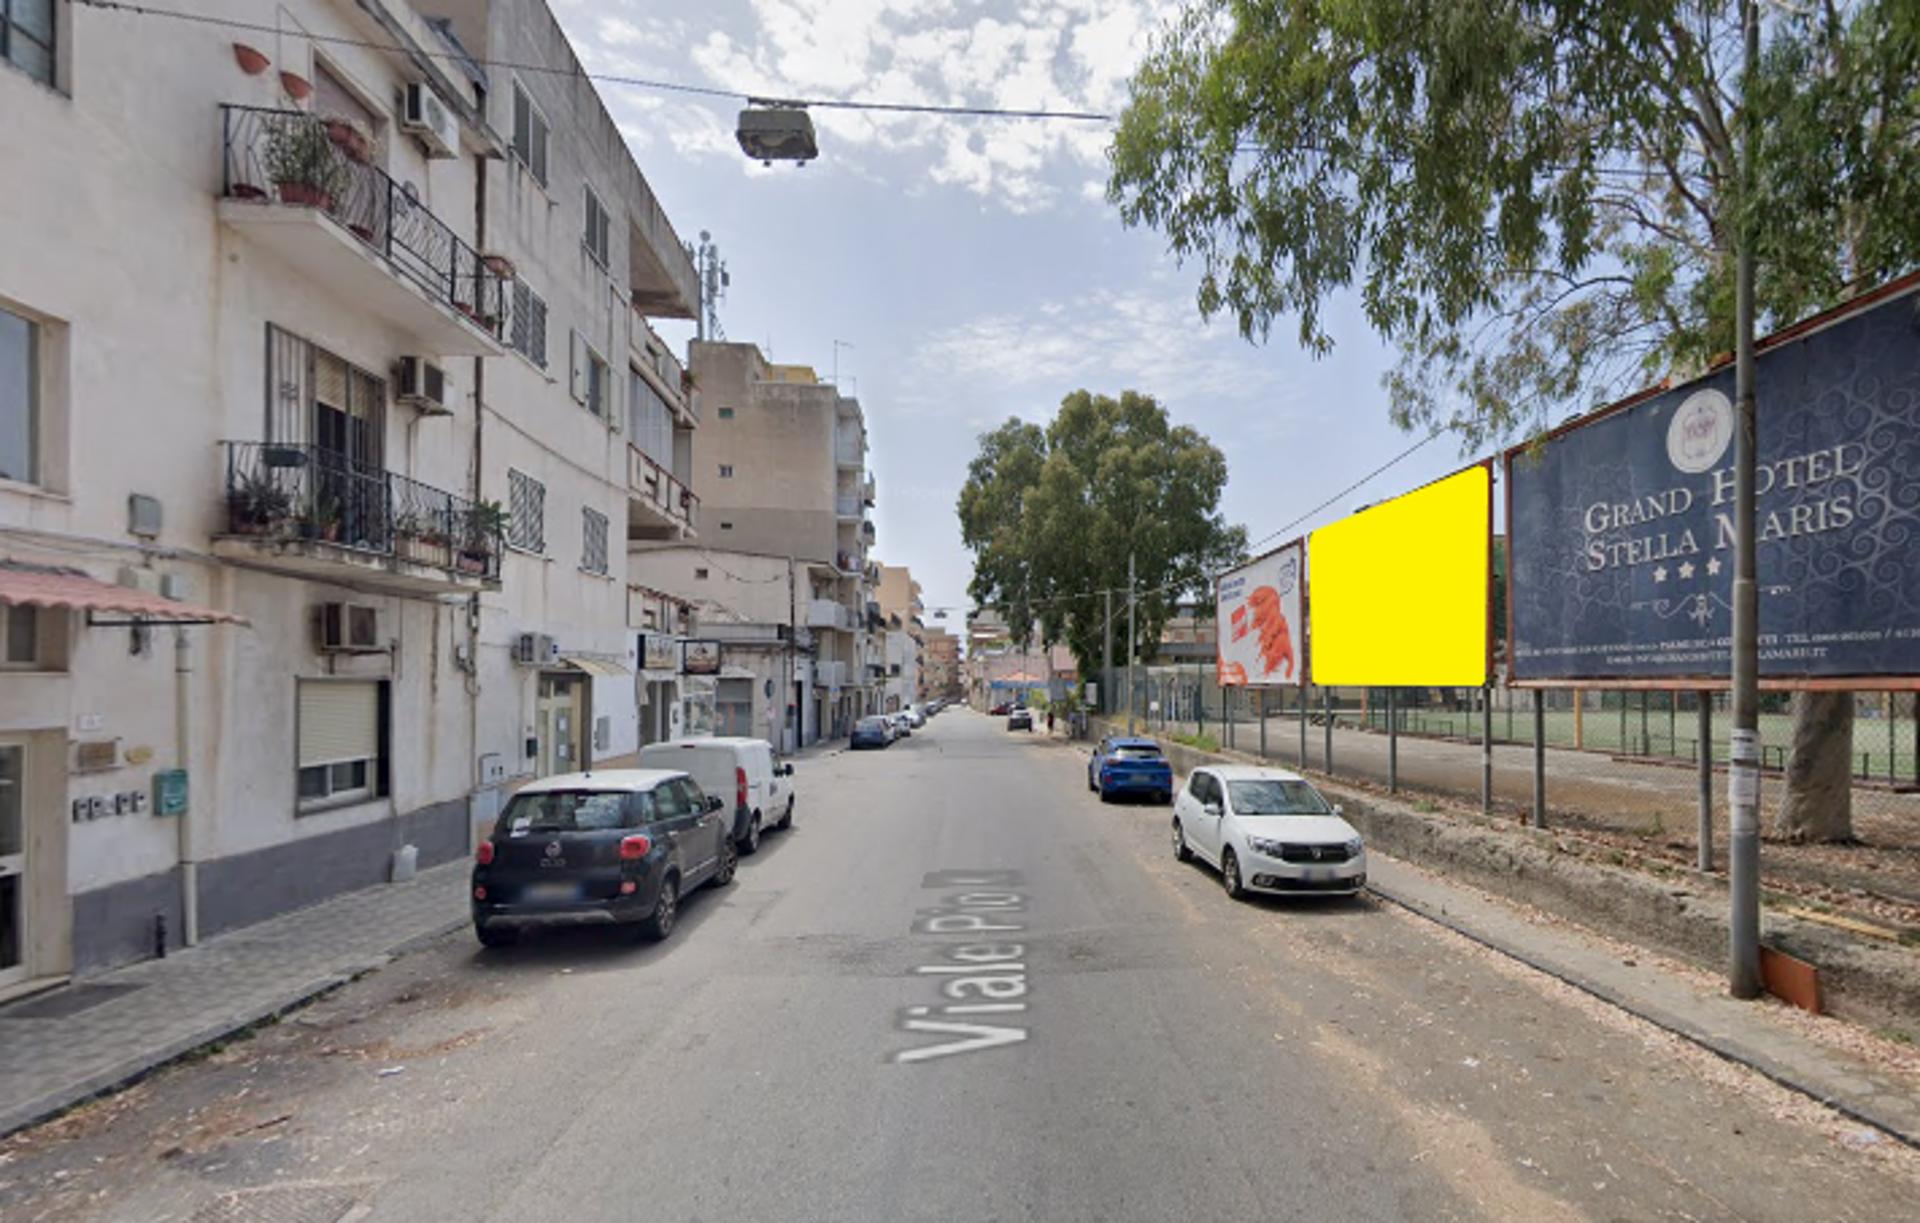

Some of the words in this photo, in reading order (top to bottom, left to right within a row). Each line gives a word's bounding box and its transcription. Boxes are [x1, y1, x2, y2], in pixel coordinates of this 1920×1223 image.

[1584, 487, 1693, 533] GRAND
[1711, 444, 1860, 507] HOTEL
[1586, 528, 1700, 571] STELLA
